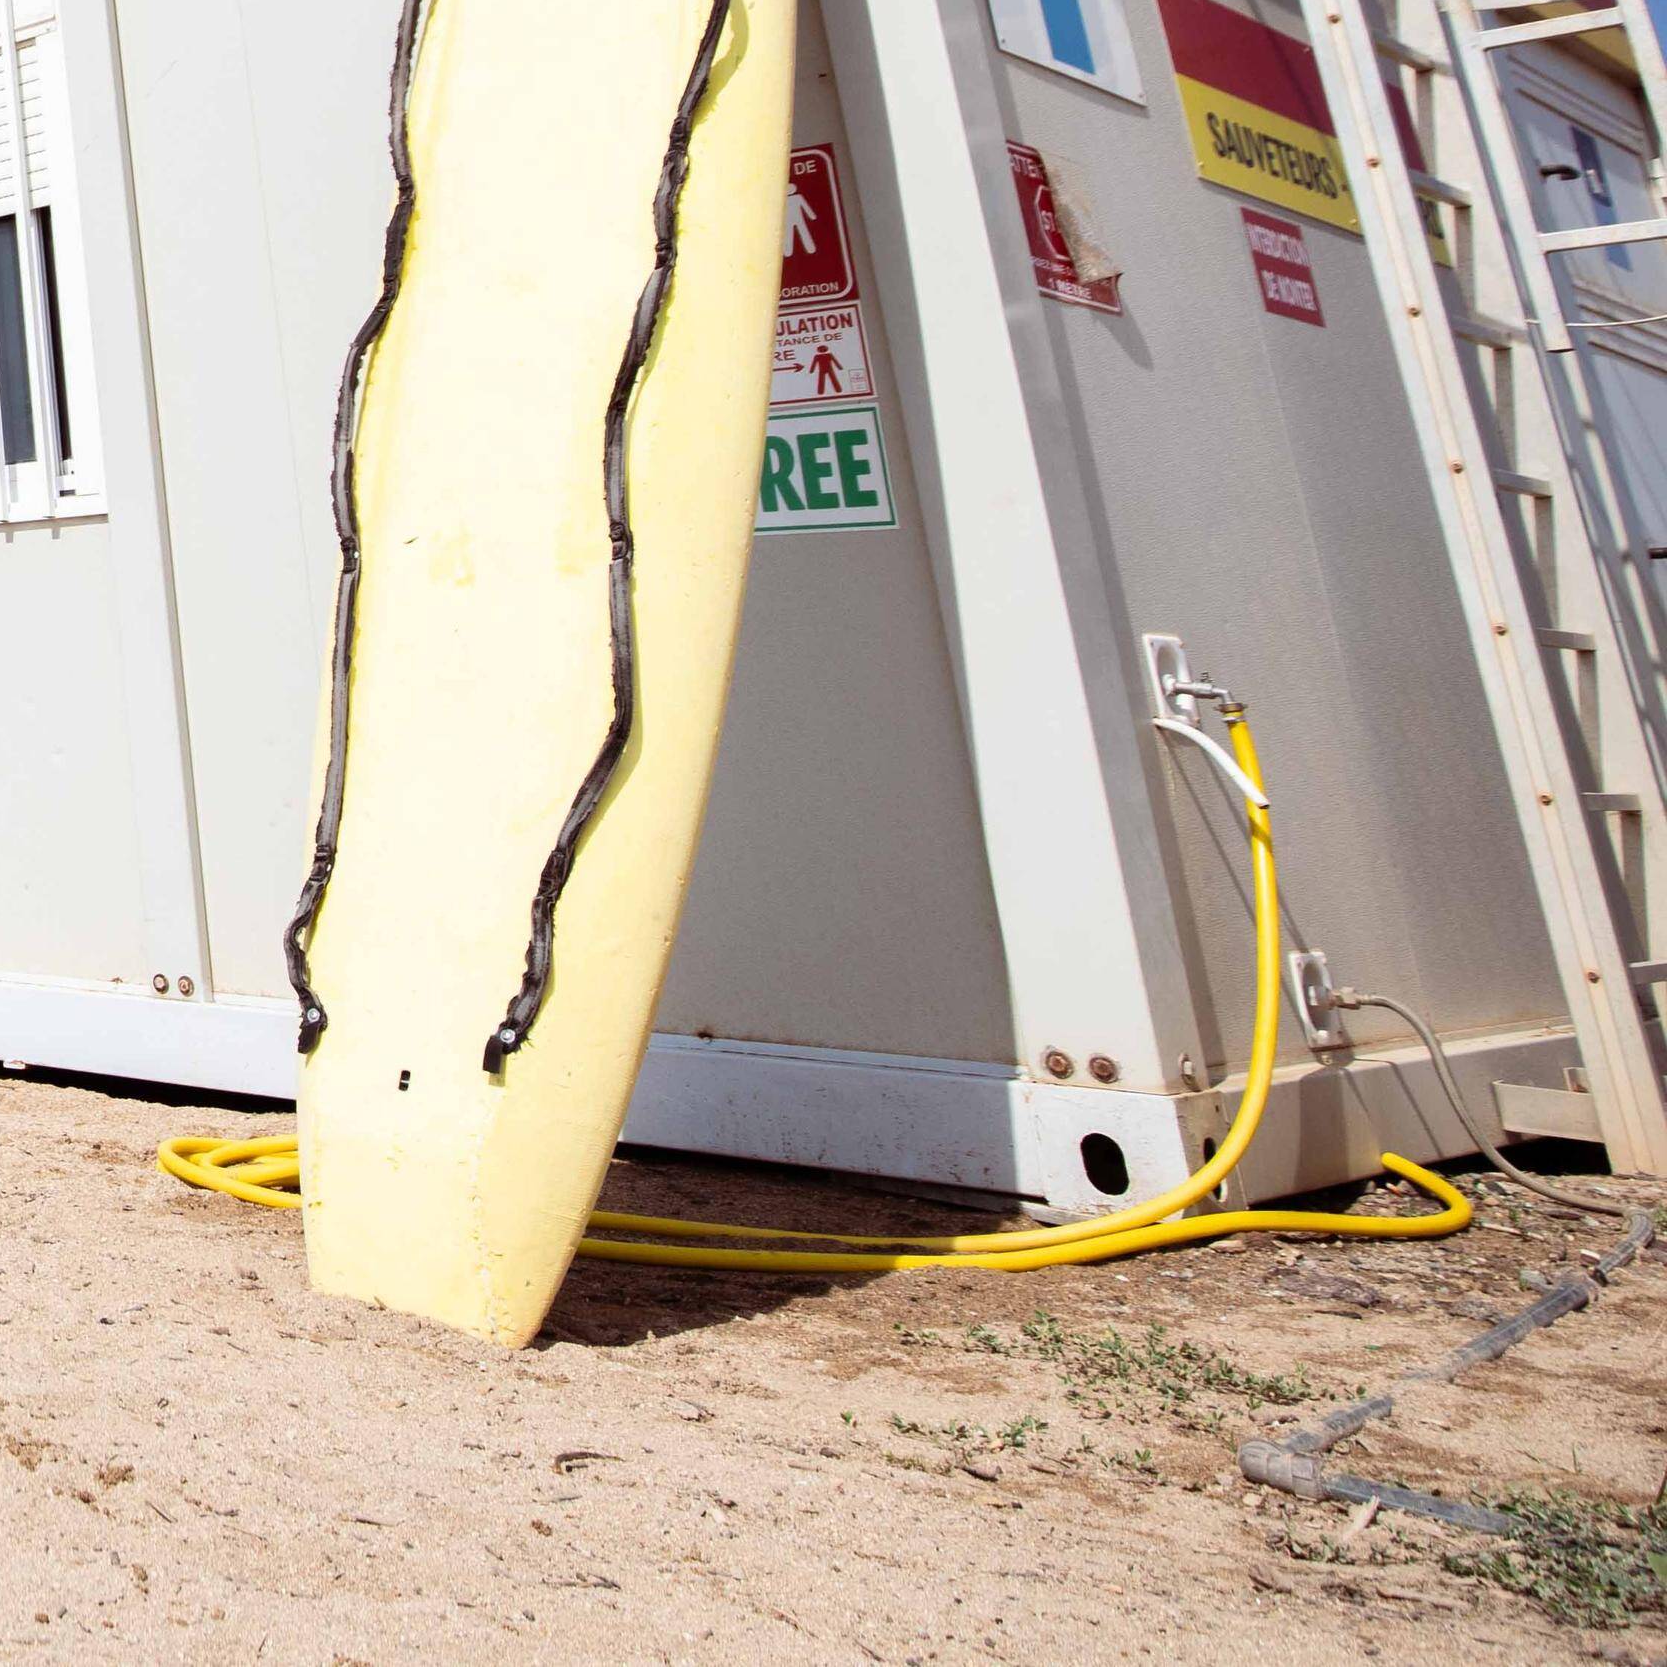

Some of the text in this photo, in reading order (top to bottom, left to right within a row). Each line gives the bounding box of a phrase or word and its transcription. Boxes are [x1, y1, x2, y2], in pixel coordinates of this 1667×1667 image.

[1206, 111, 1338, 200] SAUVETEURS
[793, 159, 817, 176] DE
[779, 281, 839, 298] ORATION
[777, 332, 844, 347] TANCE DE
[760, 428, 879, 513] REE
